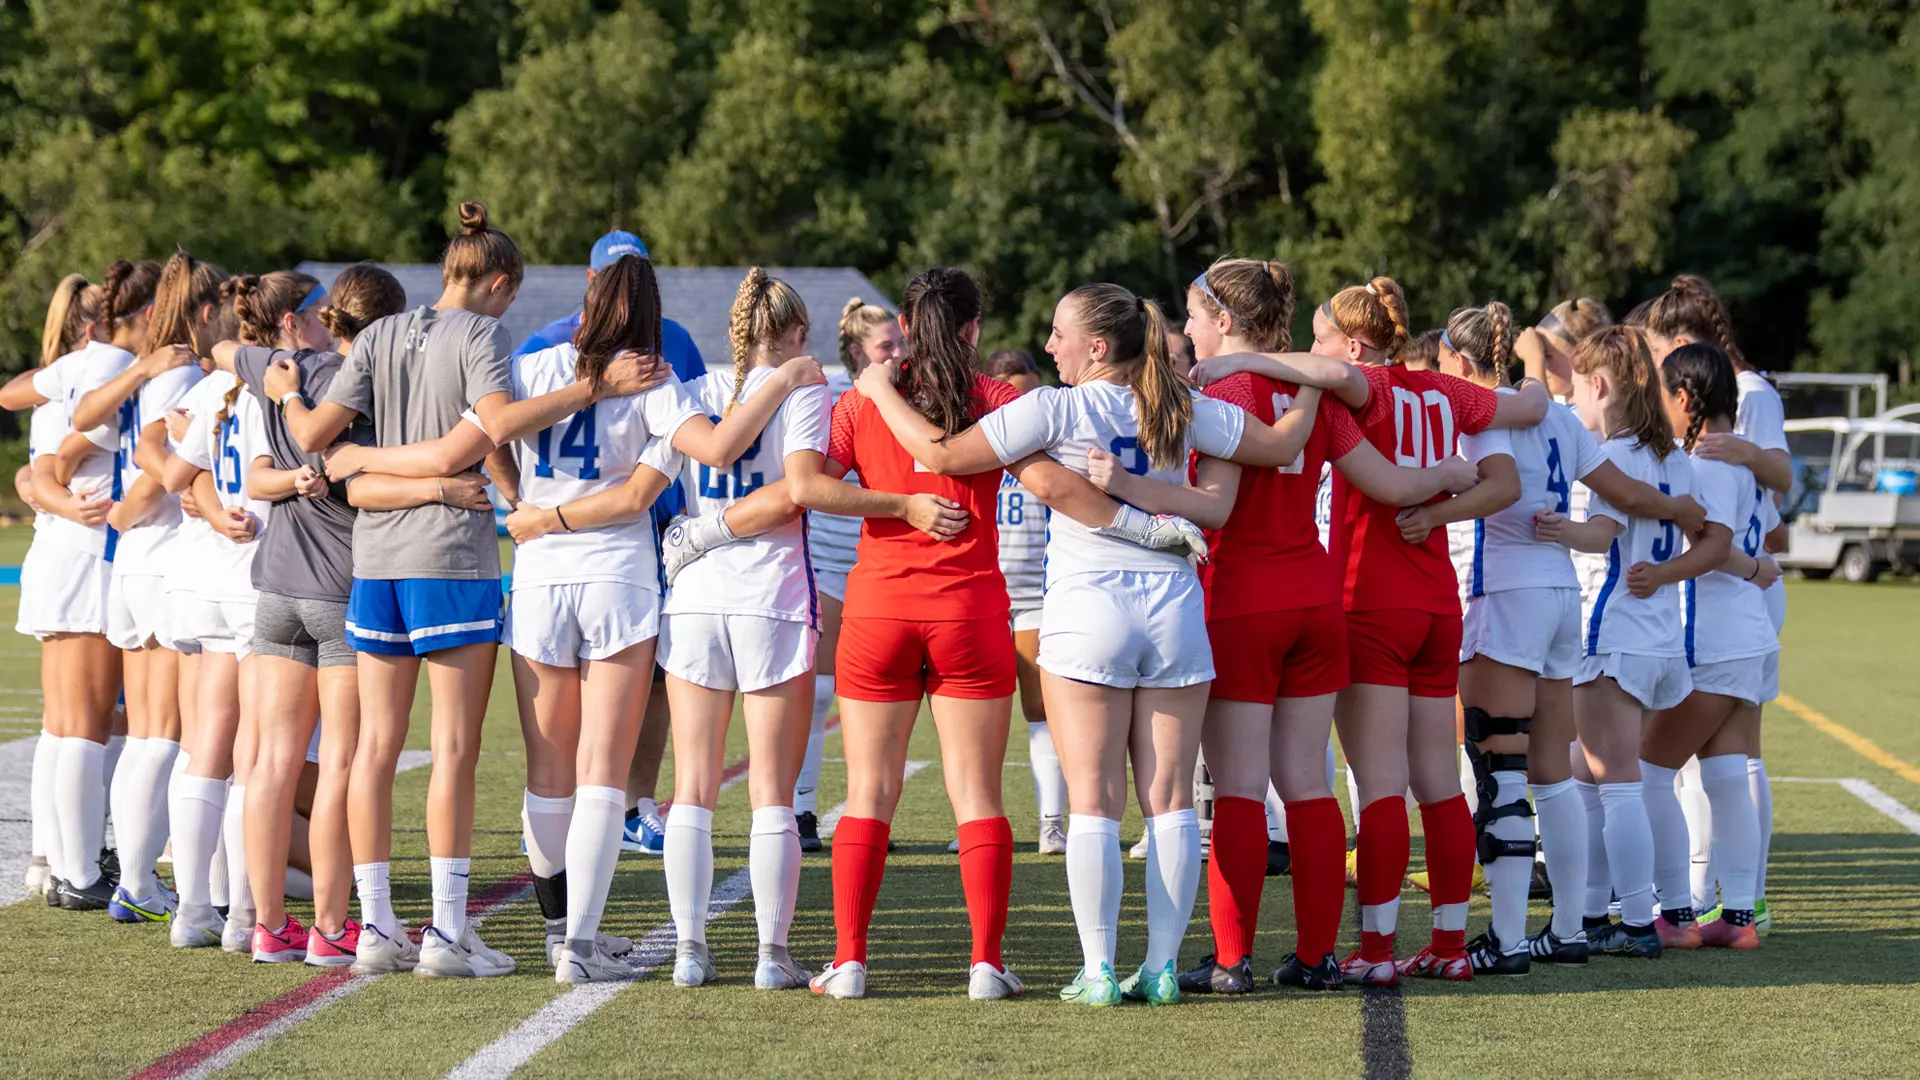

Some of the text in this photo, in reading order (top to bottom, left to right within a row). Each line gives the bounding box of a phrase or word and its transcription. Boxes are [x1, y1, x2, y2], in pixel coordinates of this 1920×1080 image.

[535, 402, 600, 480] 14
[1391, 386, 1454, 469] 00
[996, 492, 1024, 525] 18
[1546, 437, 1569, 513] 4
